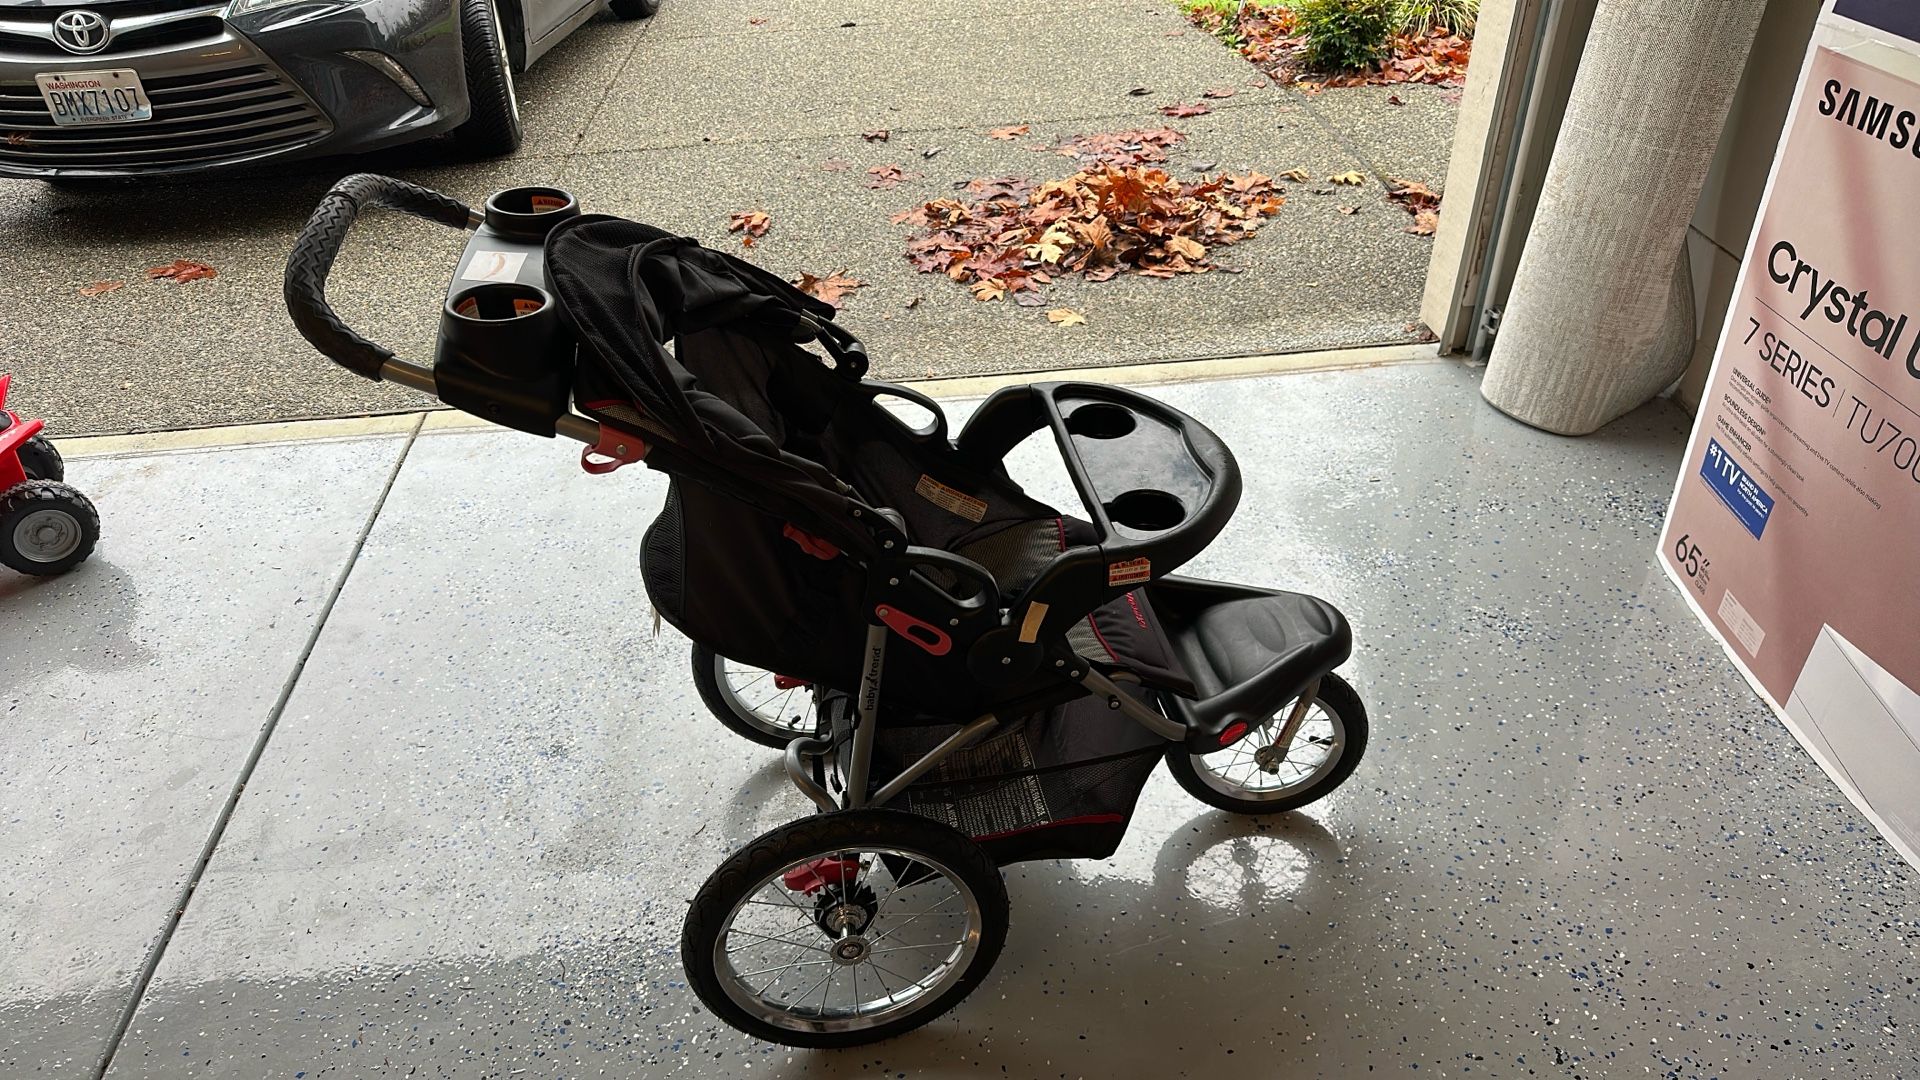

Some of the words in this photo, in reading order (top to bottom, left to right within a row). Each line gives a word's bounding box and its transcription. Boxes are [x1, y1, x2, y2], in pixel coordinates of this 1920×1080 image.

[46, 80, 101, 90] WASHINGTON
[49, 87, 139, 116] BMX7107
[1819, 79, 1920, 159] SAMS
[1768, 241, 1908, 360] Crystal
[1744, 317, 1761, 345] 7
[1758, 332, 1836, 408] SERIES
[1733, 368, 1756, 391] UNIVERSAL
[1724, 394, 1748, 420] BOUNDLESS
[1717, 415, 1730, 432] GAME
[1729, 426, 1752, 452] ENHANCER
[1710, 443, 1722, 469] #1
[1722, 456, 1740, 486] TV
[1739, 482, 1753, 498] NORTH
[1752, 494, 1768, 514] AMERICA
[869, 647, 881, 678] trend
[864, 686, 878, 711] baby
